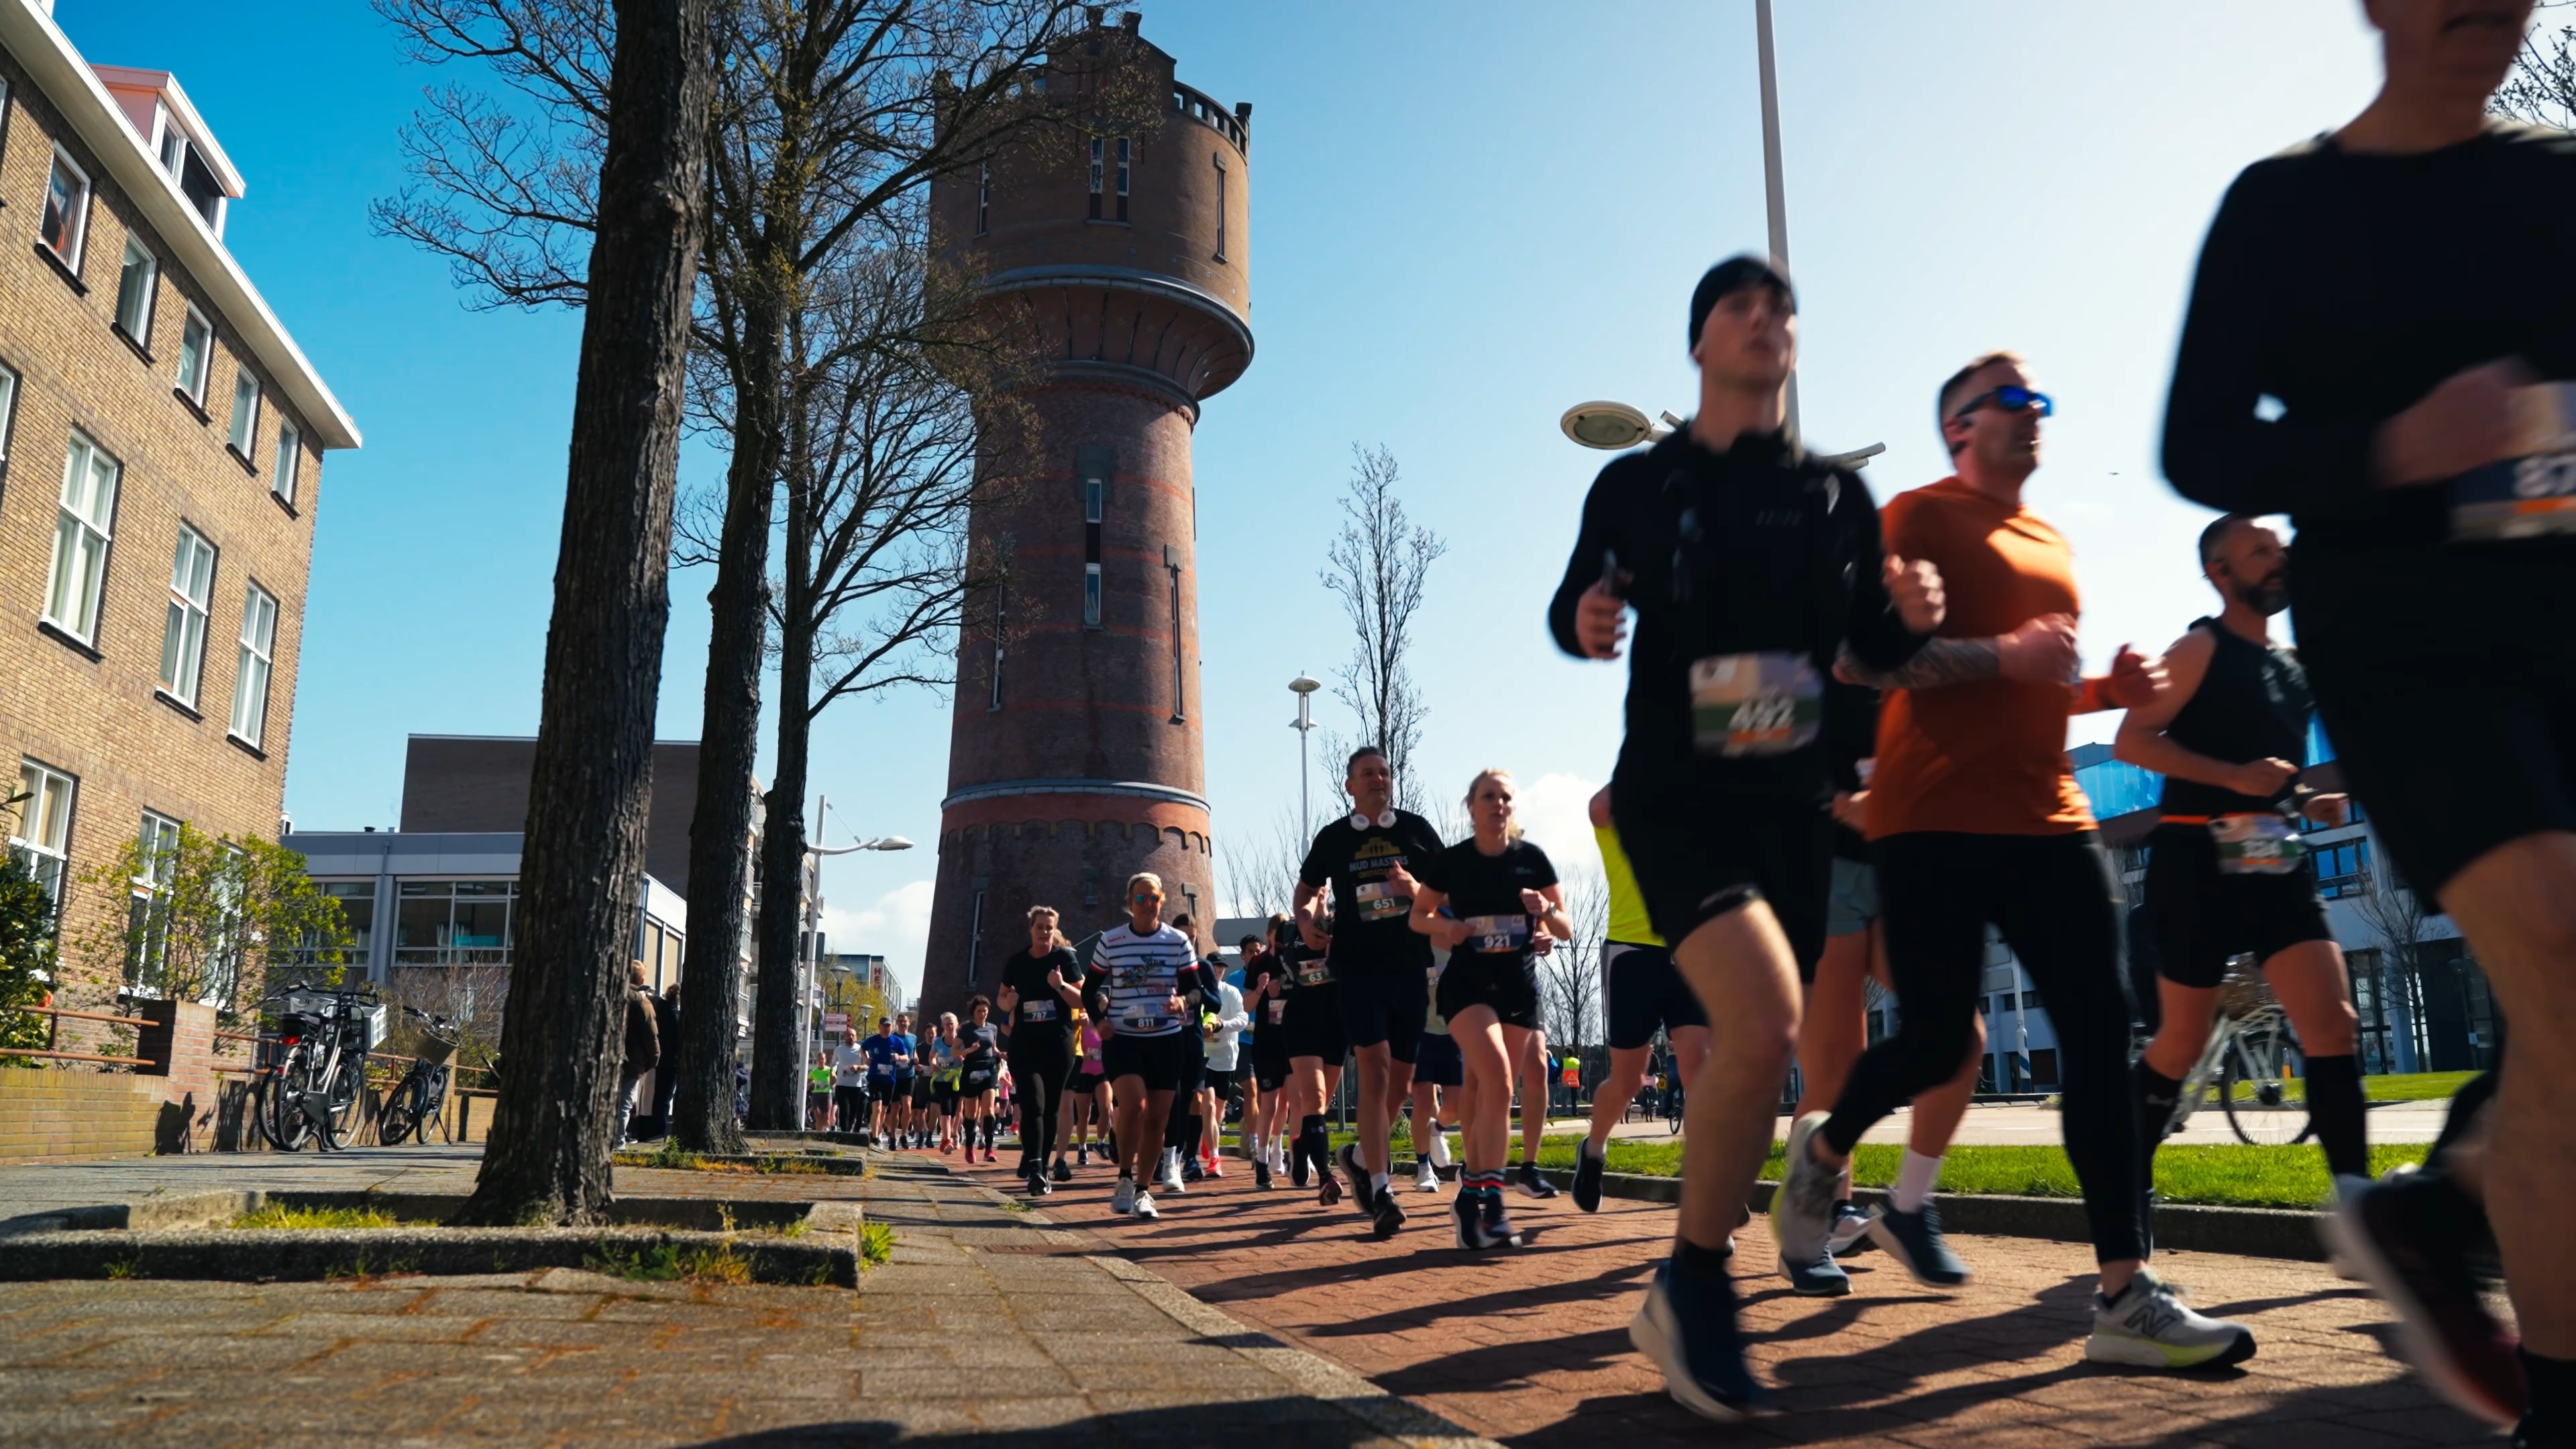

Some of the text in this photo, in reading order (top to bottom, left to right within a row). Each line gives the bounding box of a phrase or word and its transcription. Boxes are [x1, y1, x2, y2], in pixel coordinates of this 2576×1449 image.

[1349, 860, 1368, 872] MUD
[1373, 898, 1395, 910] 651
[1484, 934, 1510, 948] 921
[1309, 973, 1322, 981] 63
[1032, 1011, 1047, 1020] 787
[1138, 1018, 1155, 1027] 811
